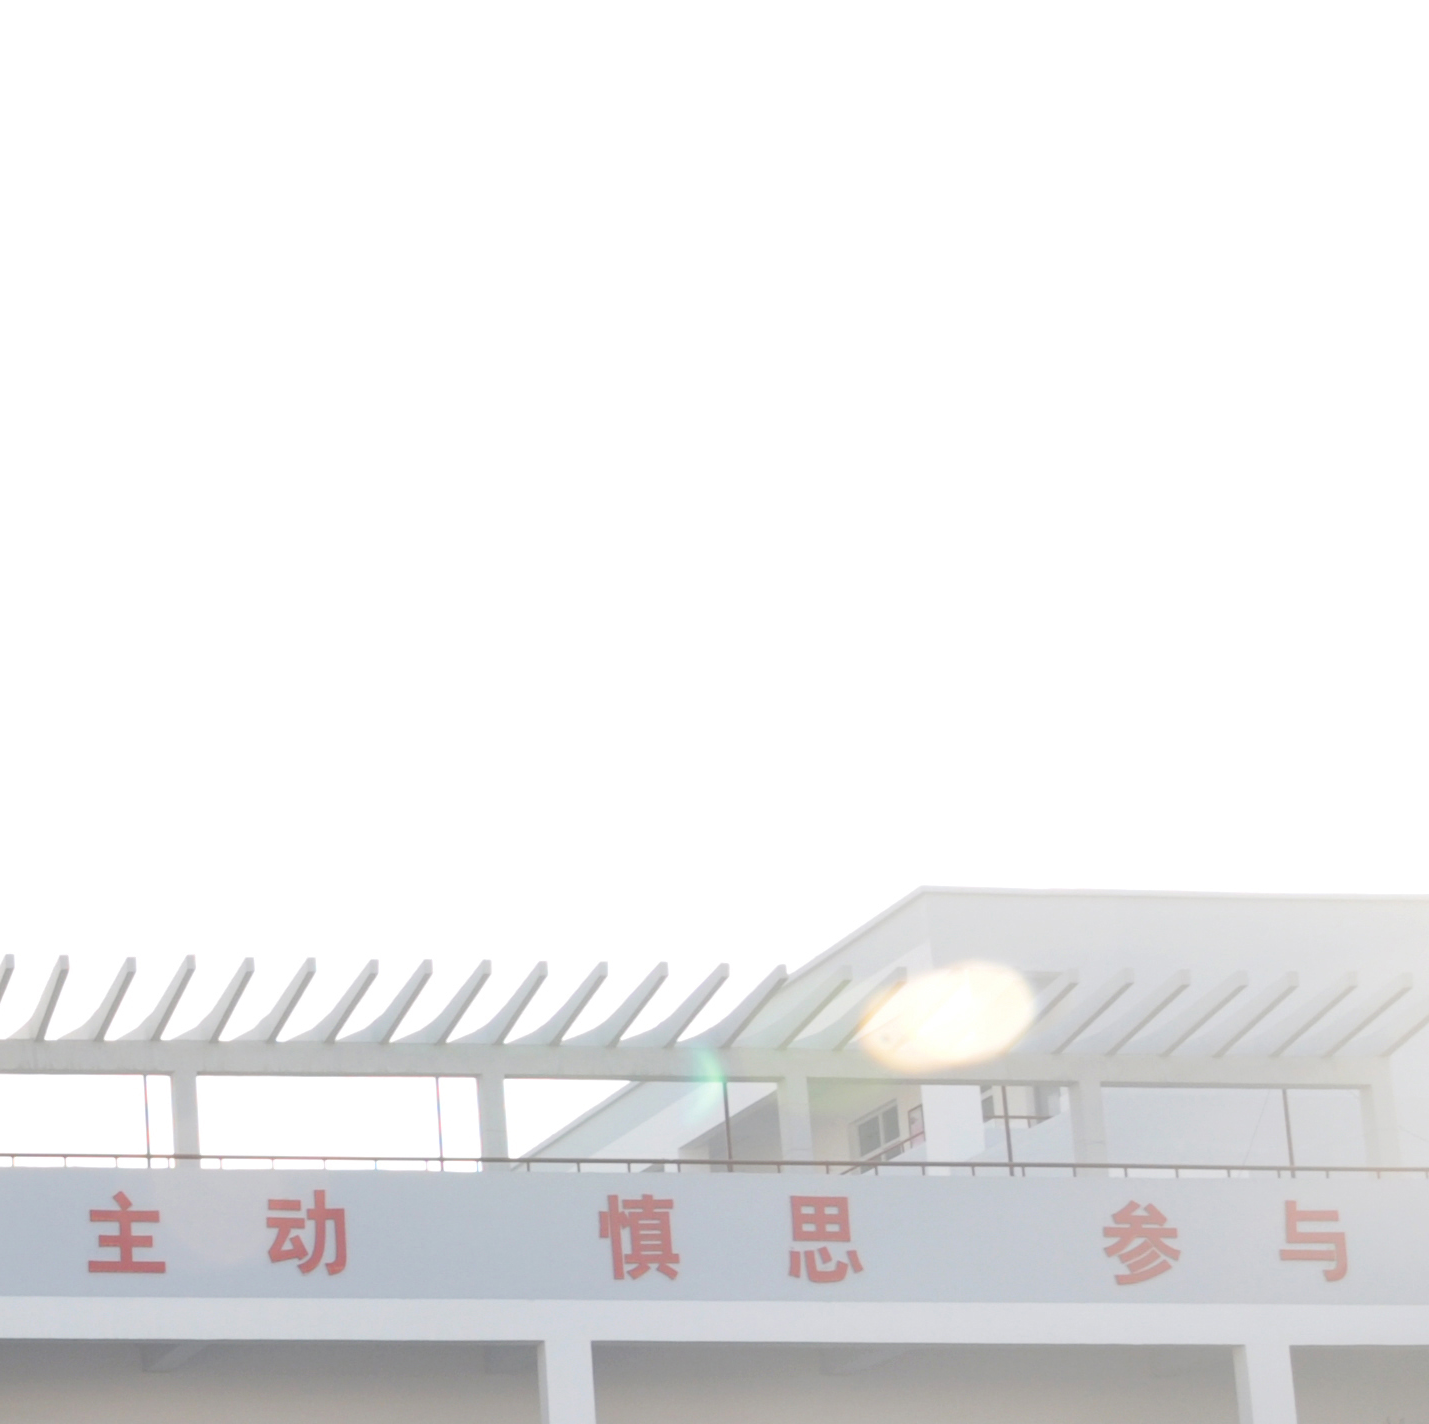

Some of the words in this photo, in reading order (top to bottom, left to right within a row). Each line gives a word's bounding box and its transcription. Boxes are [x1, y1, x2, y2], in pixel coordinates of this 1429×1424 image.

[88, 1189, 348, 1276] 主动
[598, 1194, 863, 1284] 慎思
[1102, 1199, 1349, 1286] 参与
